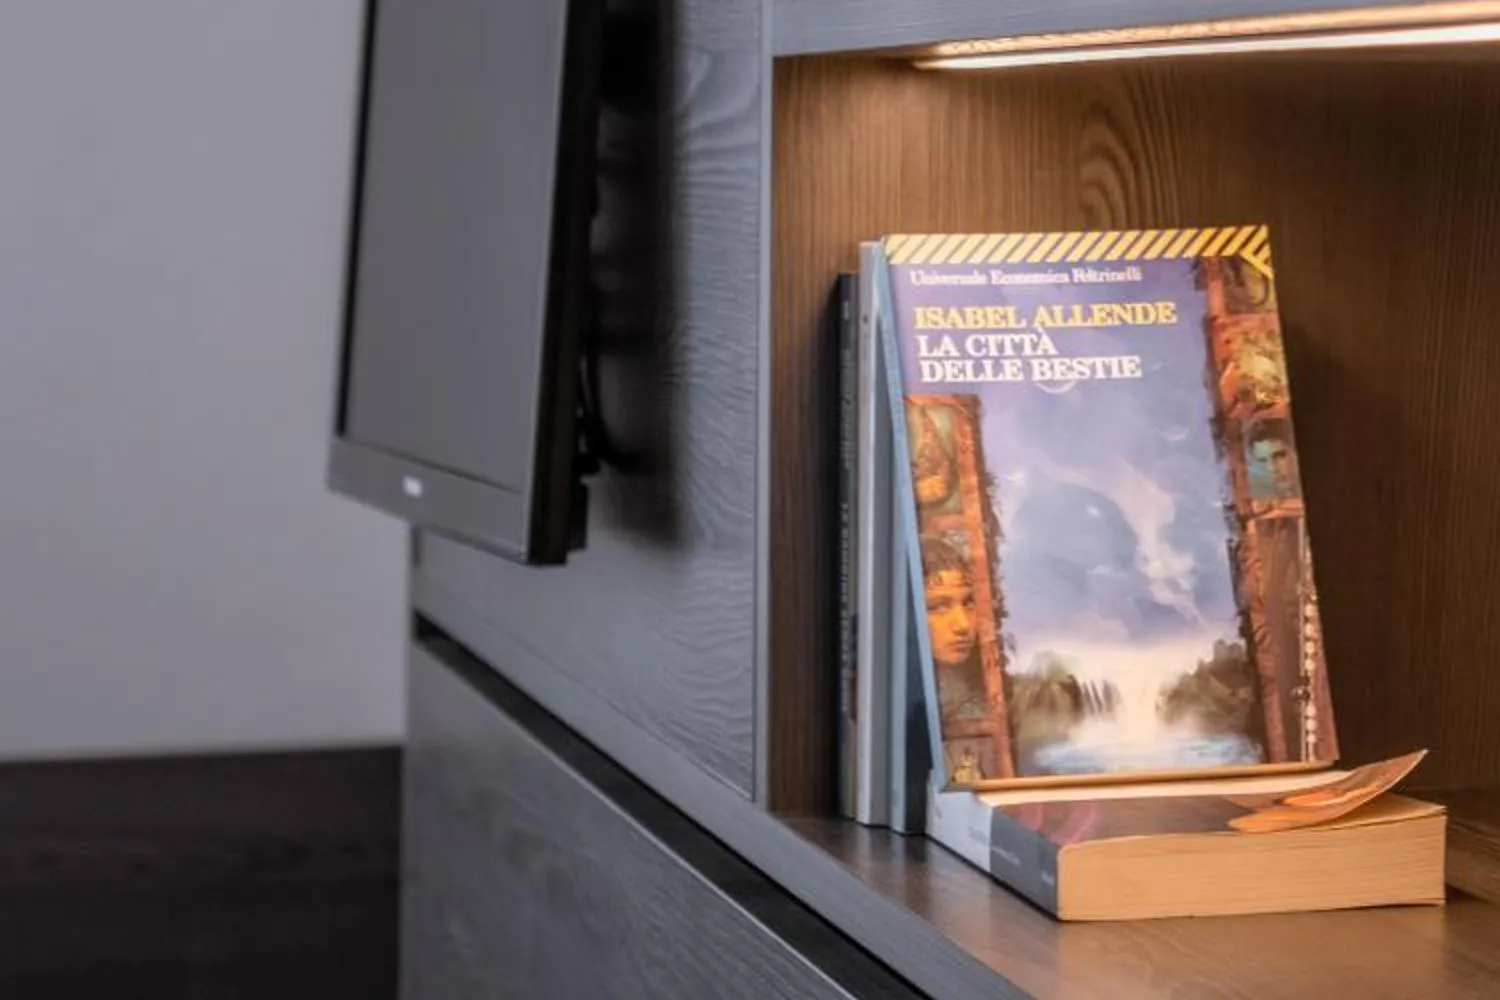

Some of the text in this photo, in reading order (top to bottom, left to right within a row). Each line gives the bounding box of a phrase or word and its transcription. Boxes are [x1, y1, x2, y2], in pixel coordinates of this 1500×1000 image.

[915, 301, 1177, 329] ISABEL ALLENDE
[917, 327, 1058, 357] LA CITTÀ
[921, 355, 1143, 382] DELLE BESTIE
